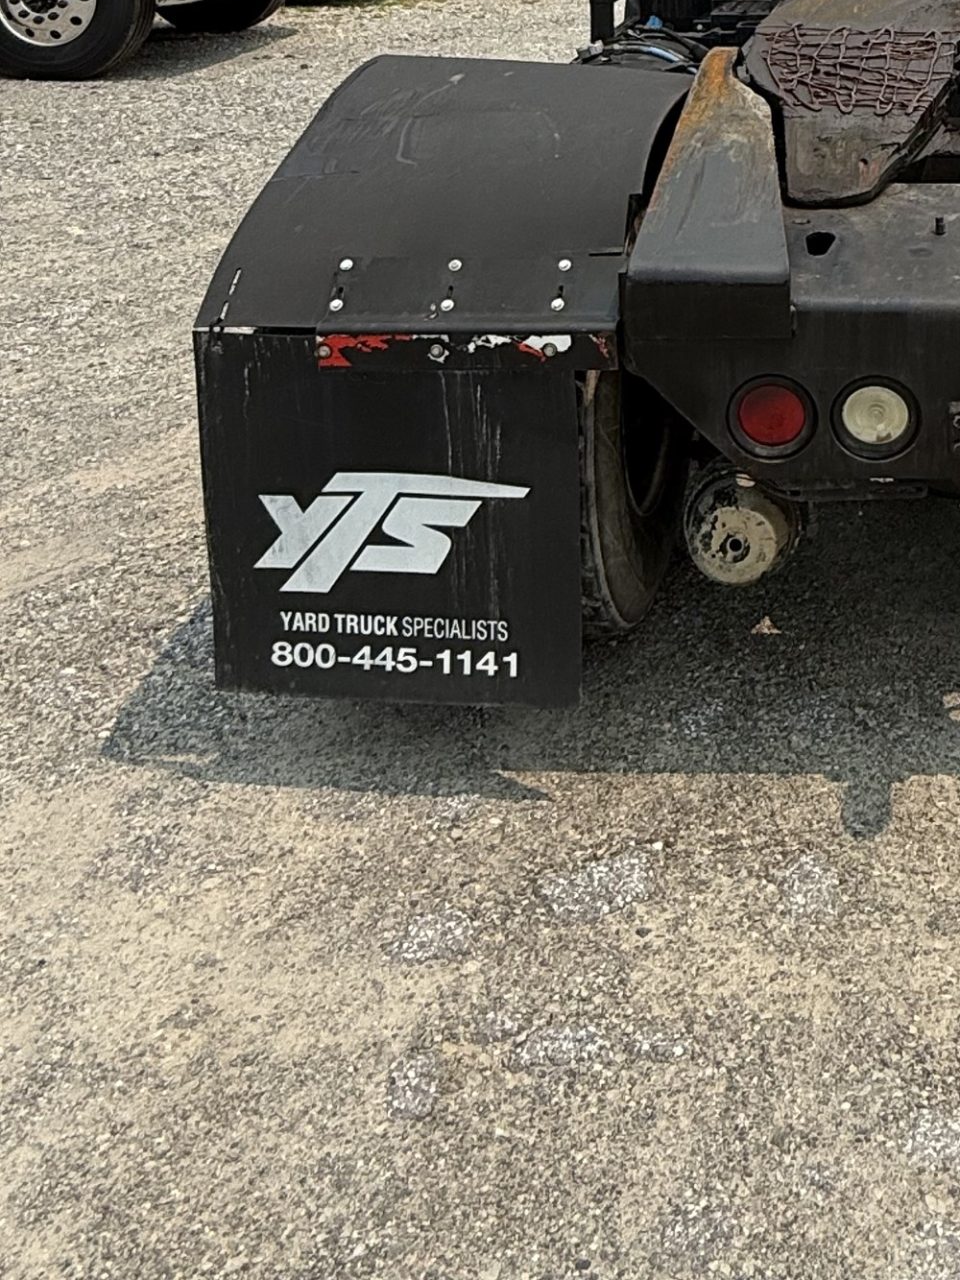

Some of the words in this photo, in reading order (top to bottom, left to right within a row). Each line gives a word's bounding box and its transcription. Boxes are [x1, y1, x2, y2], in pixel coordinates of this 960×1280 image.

[253, 472, 531, 593] YTS
[280, 611, 330, 633] YARD
[334, 613, 399, 636] TRUCK
[402, 616, 509, 641] SPECIALISTS
[270, 641, 519, 677] 800-445-1141
